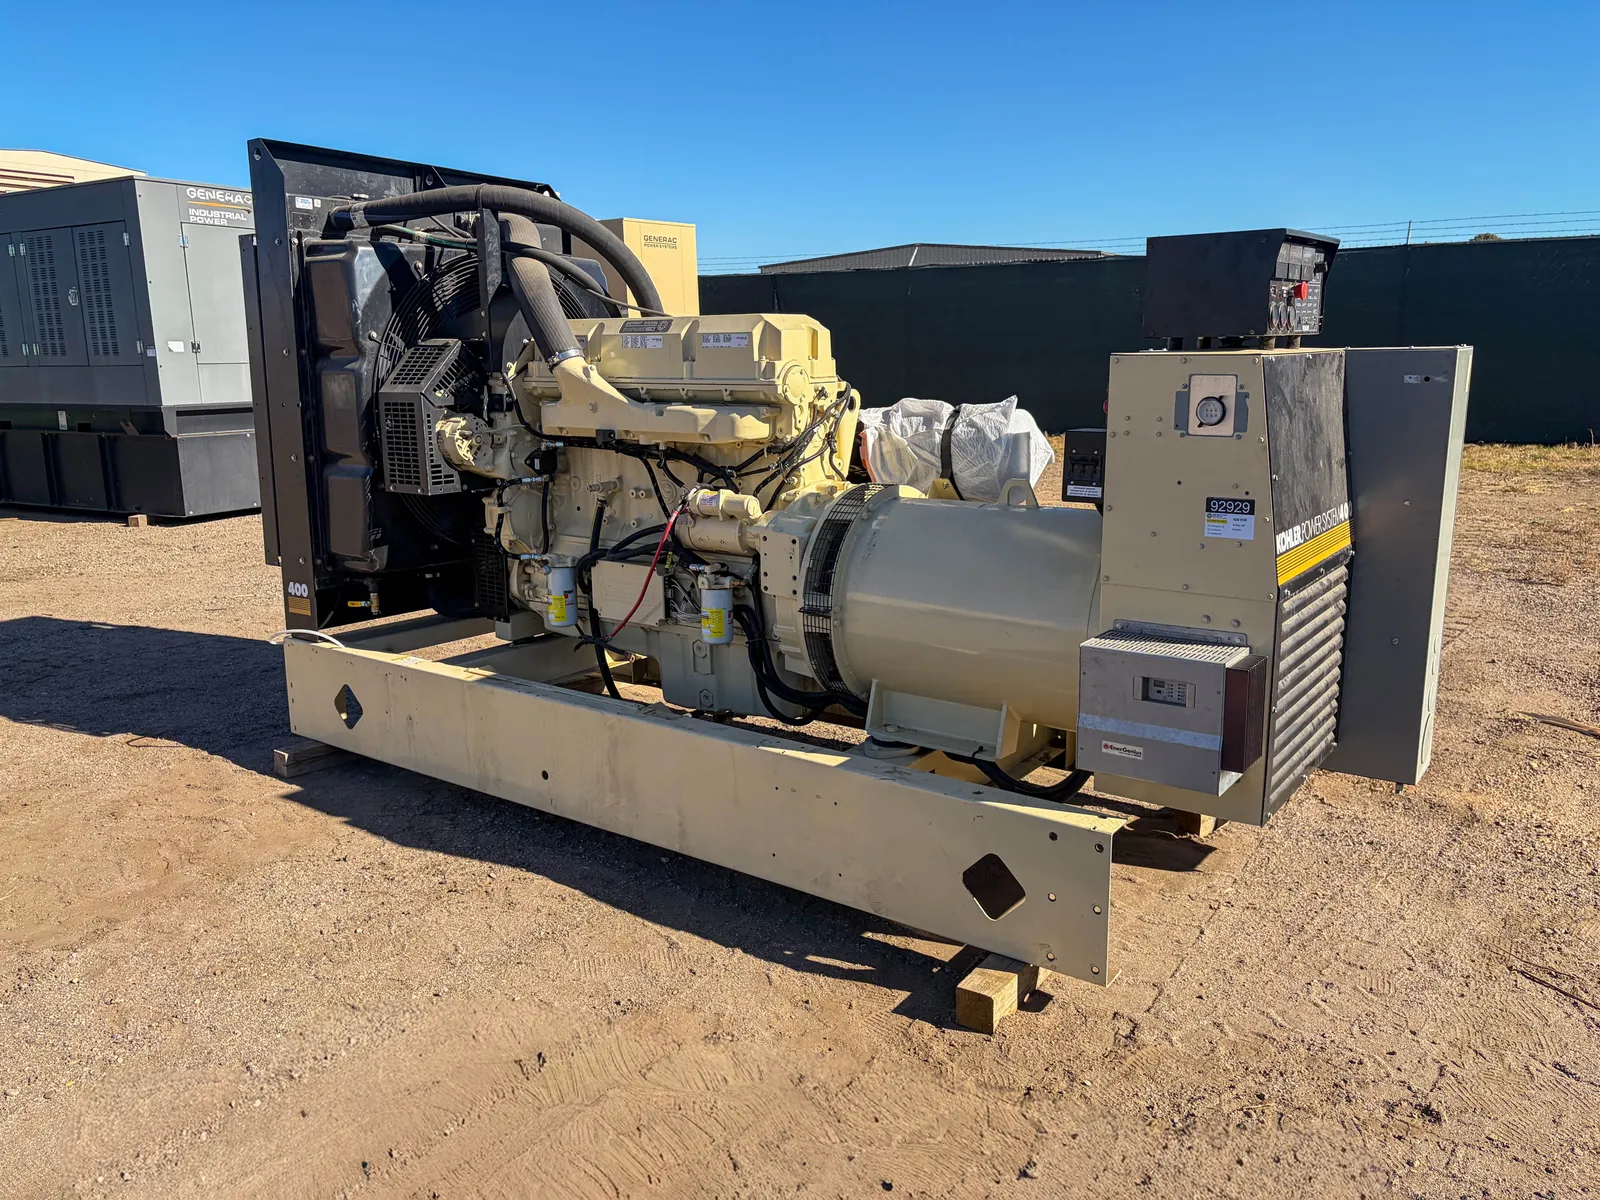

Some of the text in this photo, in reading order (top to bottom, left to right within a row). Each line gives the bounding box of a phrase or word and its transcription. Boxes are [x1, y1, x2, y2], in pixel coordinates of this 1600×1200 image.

[187, 187, 252, 204] GENERAC
[188, 208, 247, 220] INDUSTRIAL
[189, 216, 228, 225] POWER
[643, 235, 677, 243] GENERAC
[1210, 500, 1250, 513] 92929
[1276, 525, 1303, 554] KOHLER
[288, 581, 308, 597] 400
[1109, 744, 1142, 755] EnerGenius
